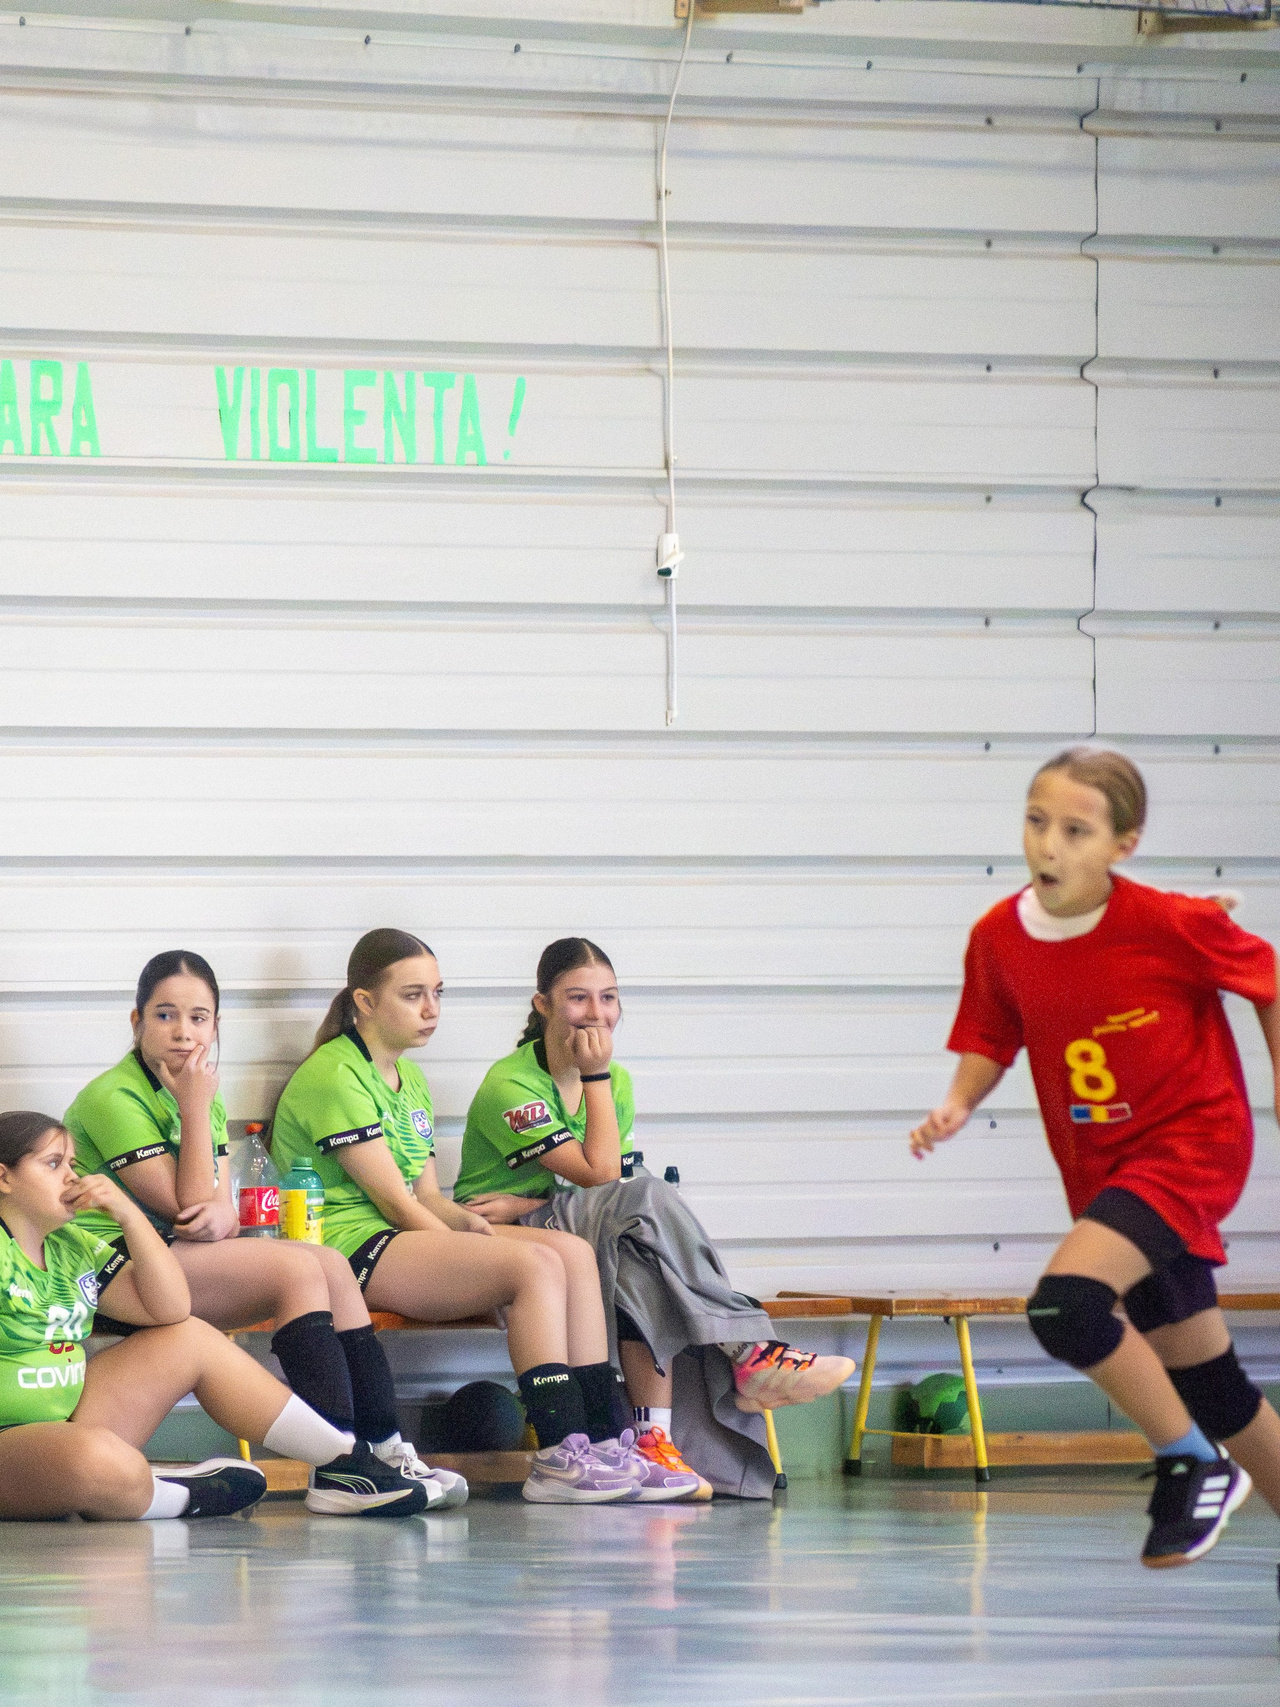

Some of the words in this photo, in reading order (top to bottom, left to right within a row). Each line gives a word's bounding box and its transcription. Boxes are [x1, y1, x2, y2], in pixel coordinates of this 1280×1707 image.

[1064, 1038, 1118, 1103] 8
[329, 1133, 360, 1147] Kempa
[136, 1145, 165, 1159] Kempa
[367, 1235, 389, 1260] Kempa
[104, 1254, 125, 1275] Kemp
[533, 1373, 569, 1387] Kempa
